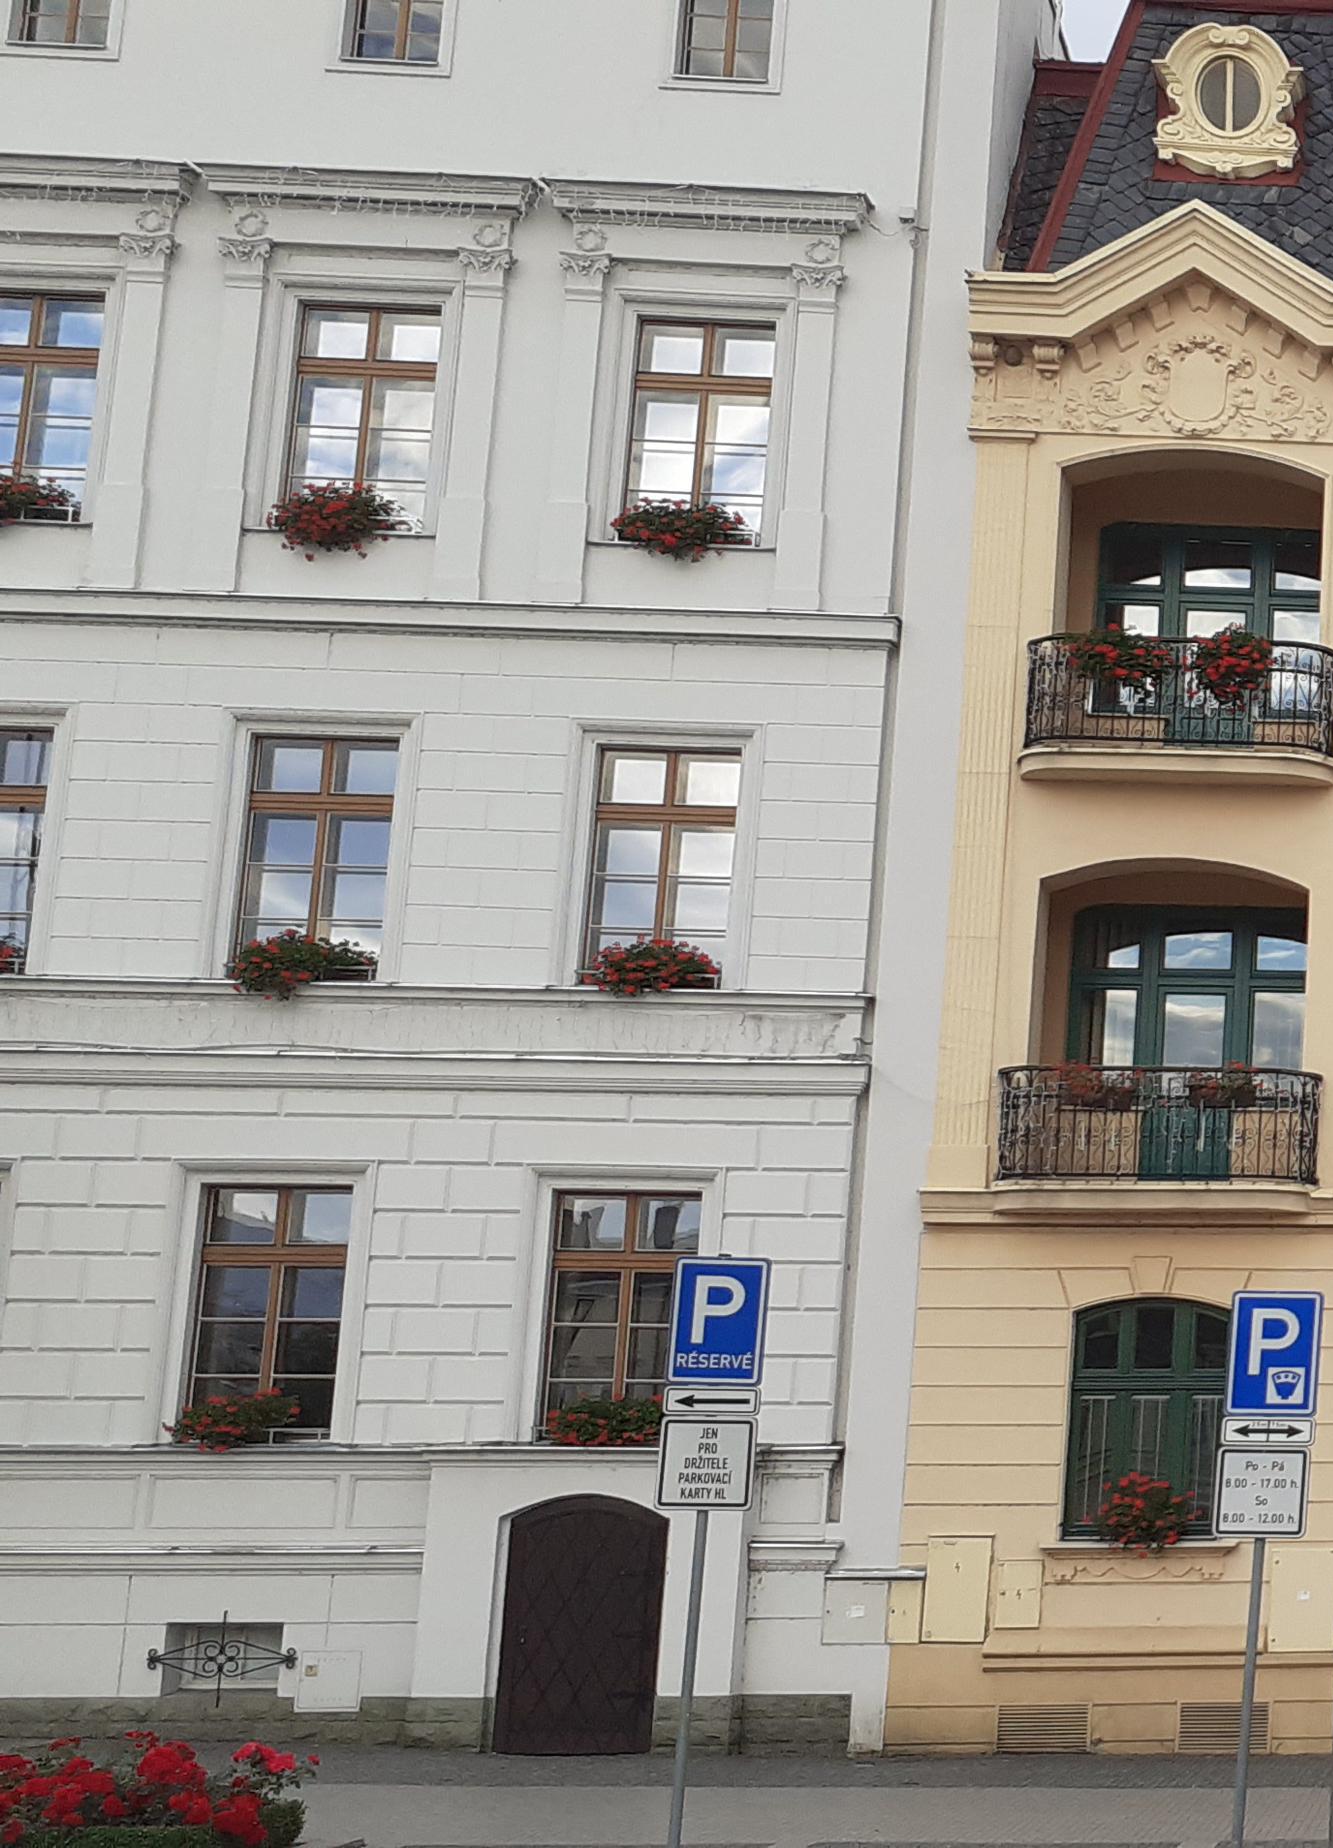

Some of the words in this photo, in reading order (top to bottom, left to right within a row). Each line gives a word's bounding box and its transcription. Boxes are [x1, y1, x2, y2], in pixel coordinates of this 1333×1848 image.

[690, 1274, 746, 1344] P
[1247, 1307, 1301, 1376] P
[675, 1350, 753, 1370] RÉSERVÉ
[699, 1426, 719, 1440] JEN
[697, 1442, 718, 1455] PRO
[683, 1455, 729, 1470] DRŽITELE
[1244, 1460, 1259, 1472] Po
[1271, 1460, 1286, 1472] Pá
[678, 1470, 733, 1485] PARKOVACÍ
[1224, 1477, 1248, 1489] 8.00
[1260, 1477, 1288, 1489] 17.00
[680, 1487, 712, 1500] KARTY
[714, 1487, 727, 1500] HL
[1254, 1494, 1269, 1506] So
[1222, 1512, 1246, 1524] 8.00
[1258, 1512, 1285, 1524] 12.00
